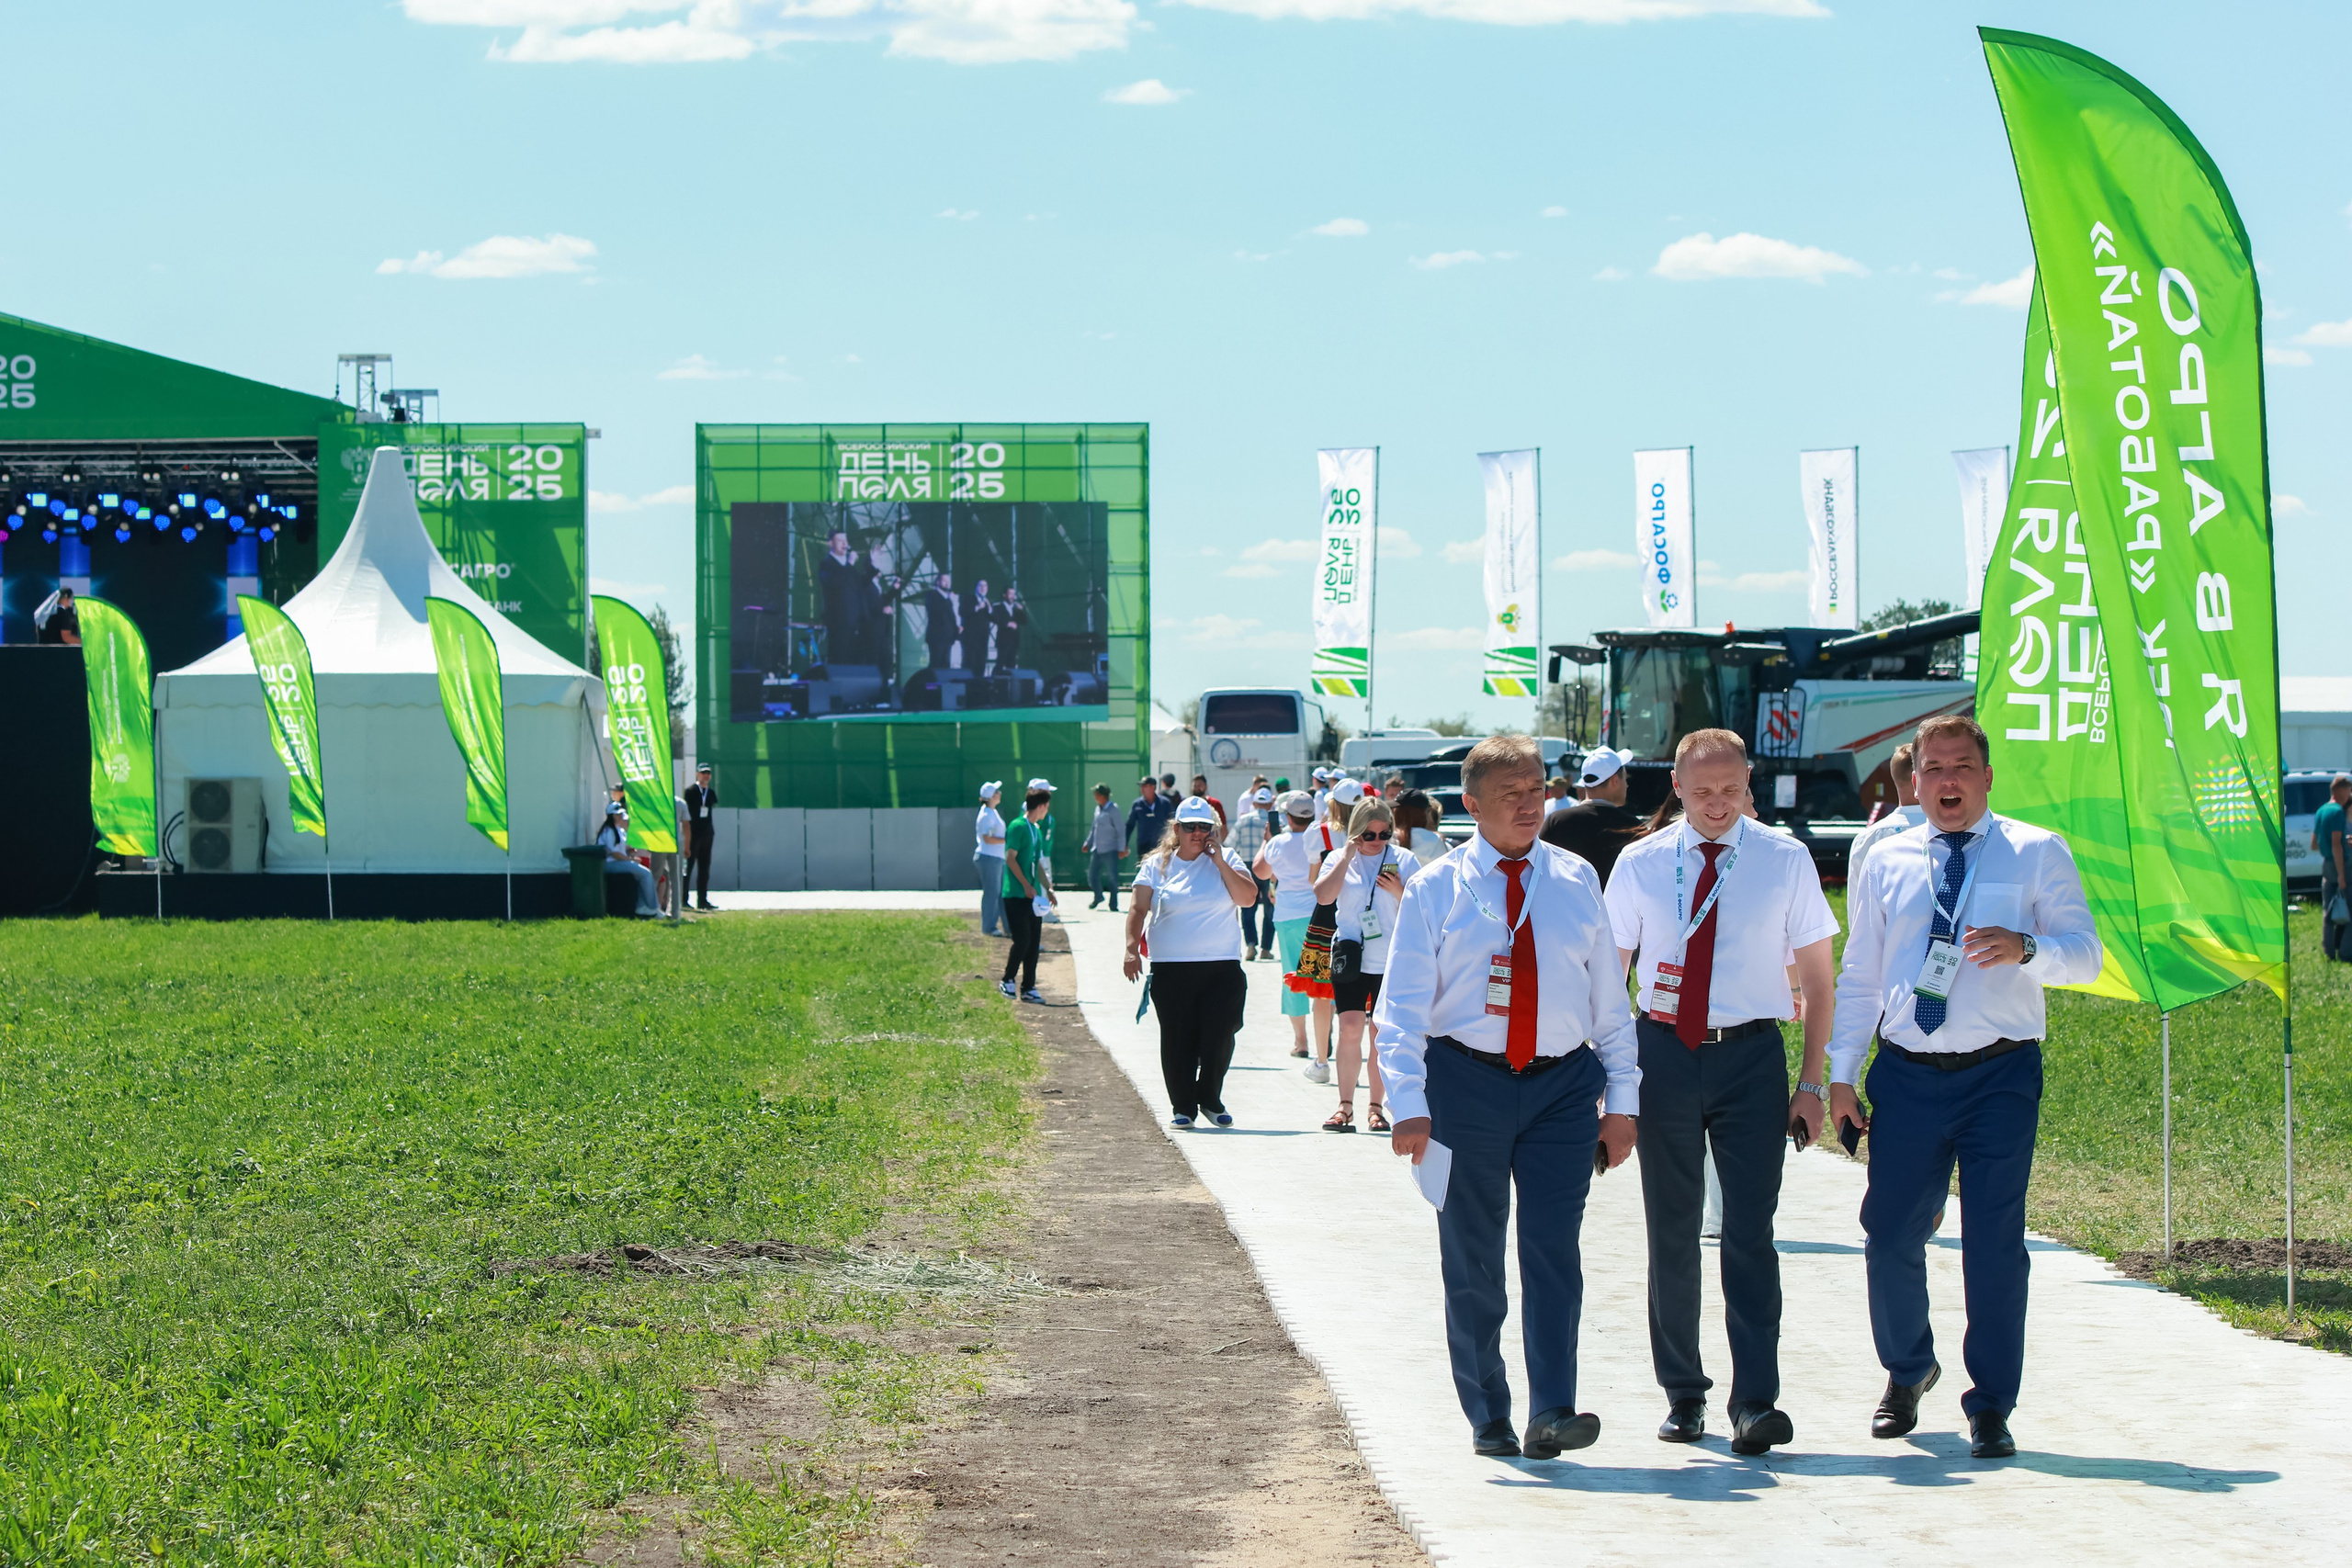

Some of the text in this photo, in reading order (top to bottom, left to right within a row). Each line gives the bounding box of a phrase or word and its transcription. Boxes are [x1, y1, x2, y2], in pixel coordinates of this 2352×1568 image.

[507, 445, 563, 470] 20
[838, 452, 931, 475] ДЕНЬ
[950, 443, 994, 468] 20
[507, 474, 563, 501] 25
[838, 476, 931, 499] ПОЛЯ
[950, 472, 994, 499] 25
